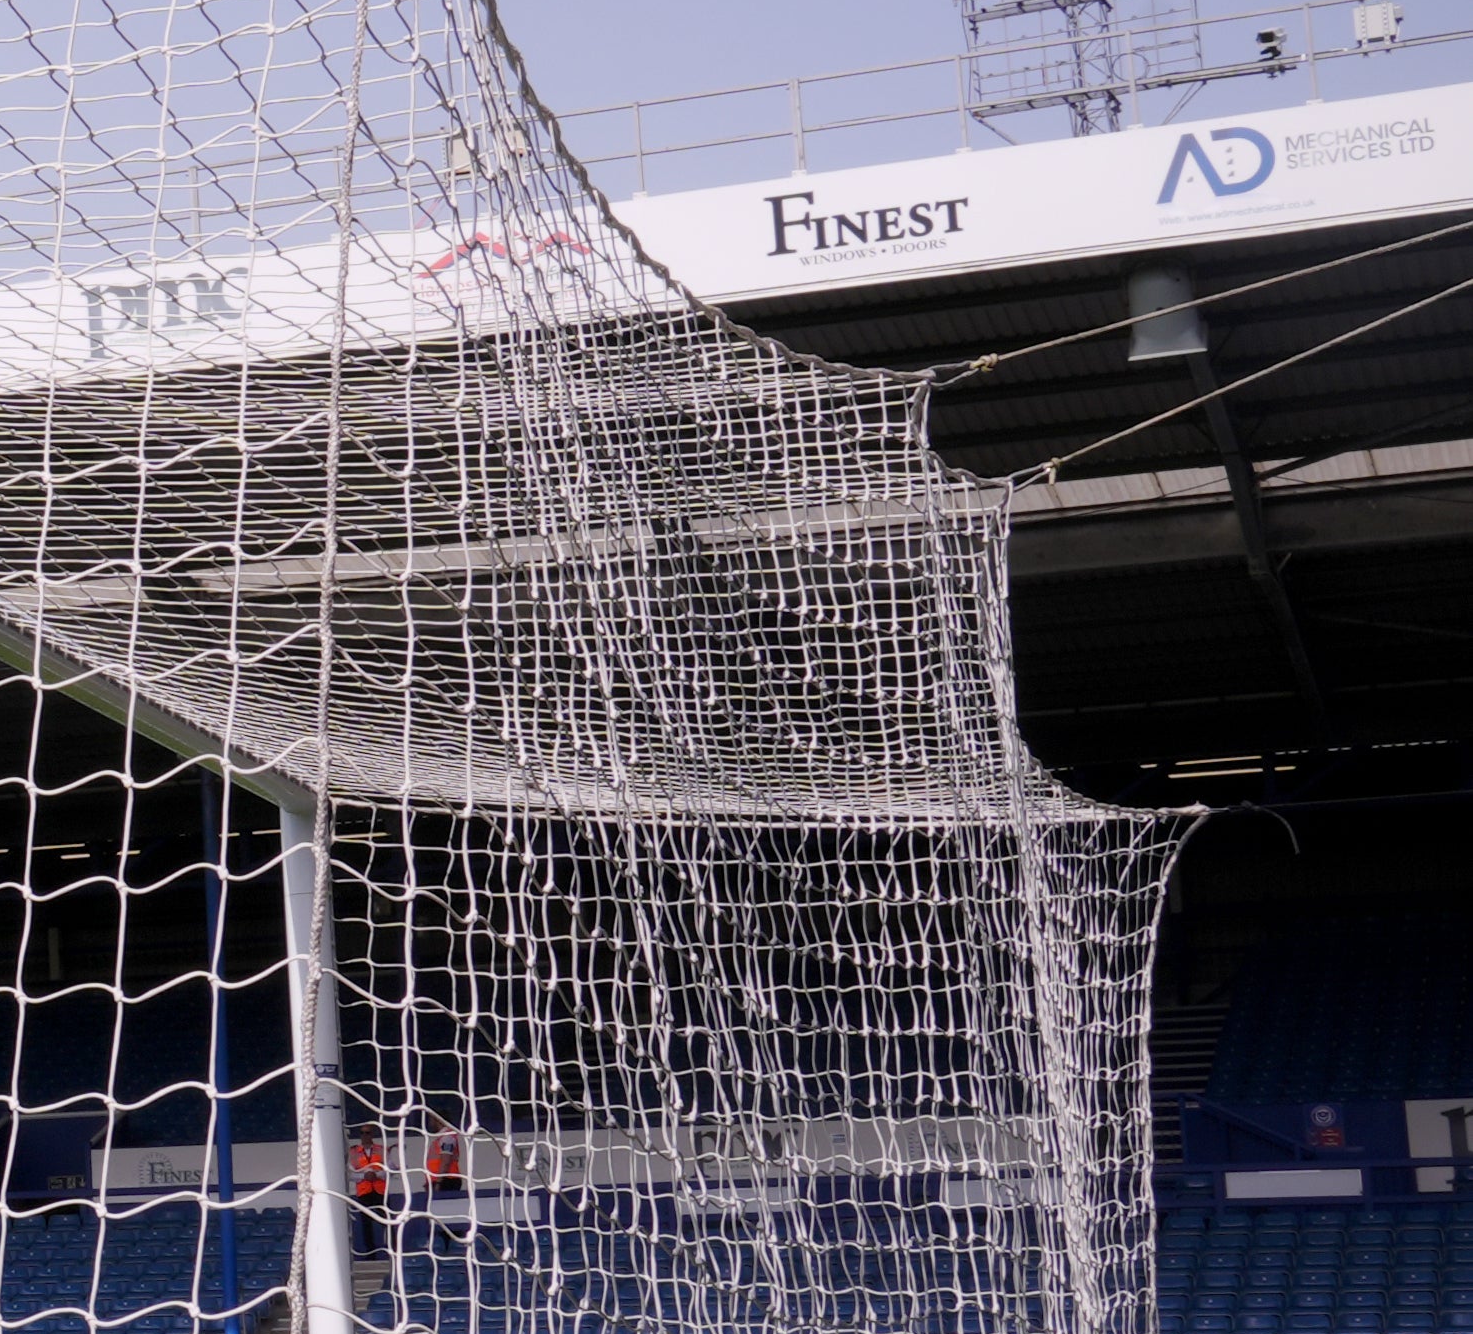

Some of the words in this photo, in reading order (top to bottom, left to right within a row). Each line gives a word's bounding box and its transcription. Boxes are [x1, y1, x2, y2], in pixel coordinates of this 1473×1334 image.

[1285, 118, 1435, 153] MECHANICAL
[1286, 142, 1392, 169] SERVICES
[1400, 135, 1435, 155] LTD
[763, 191, 969, 256] FINEST
[799, 247, 877, 267] WINDOWS
[893, 238, 947, 255] DOORS
[148, 1161, 212, 1184] FINES
